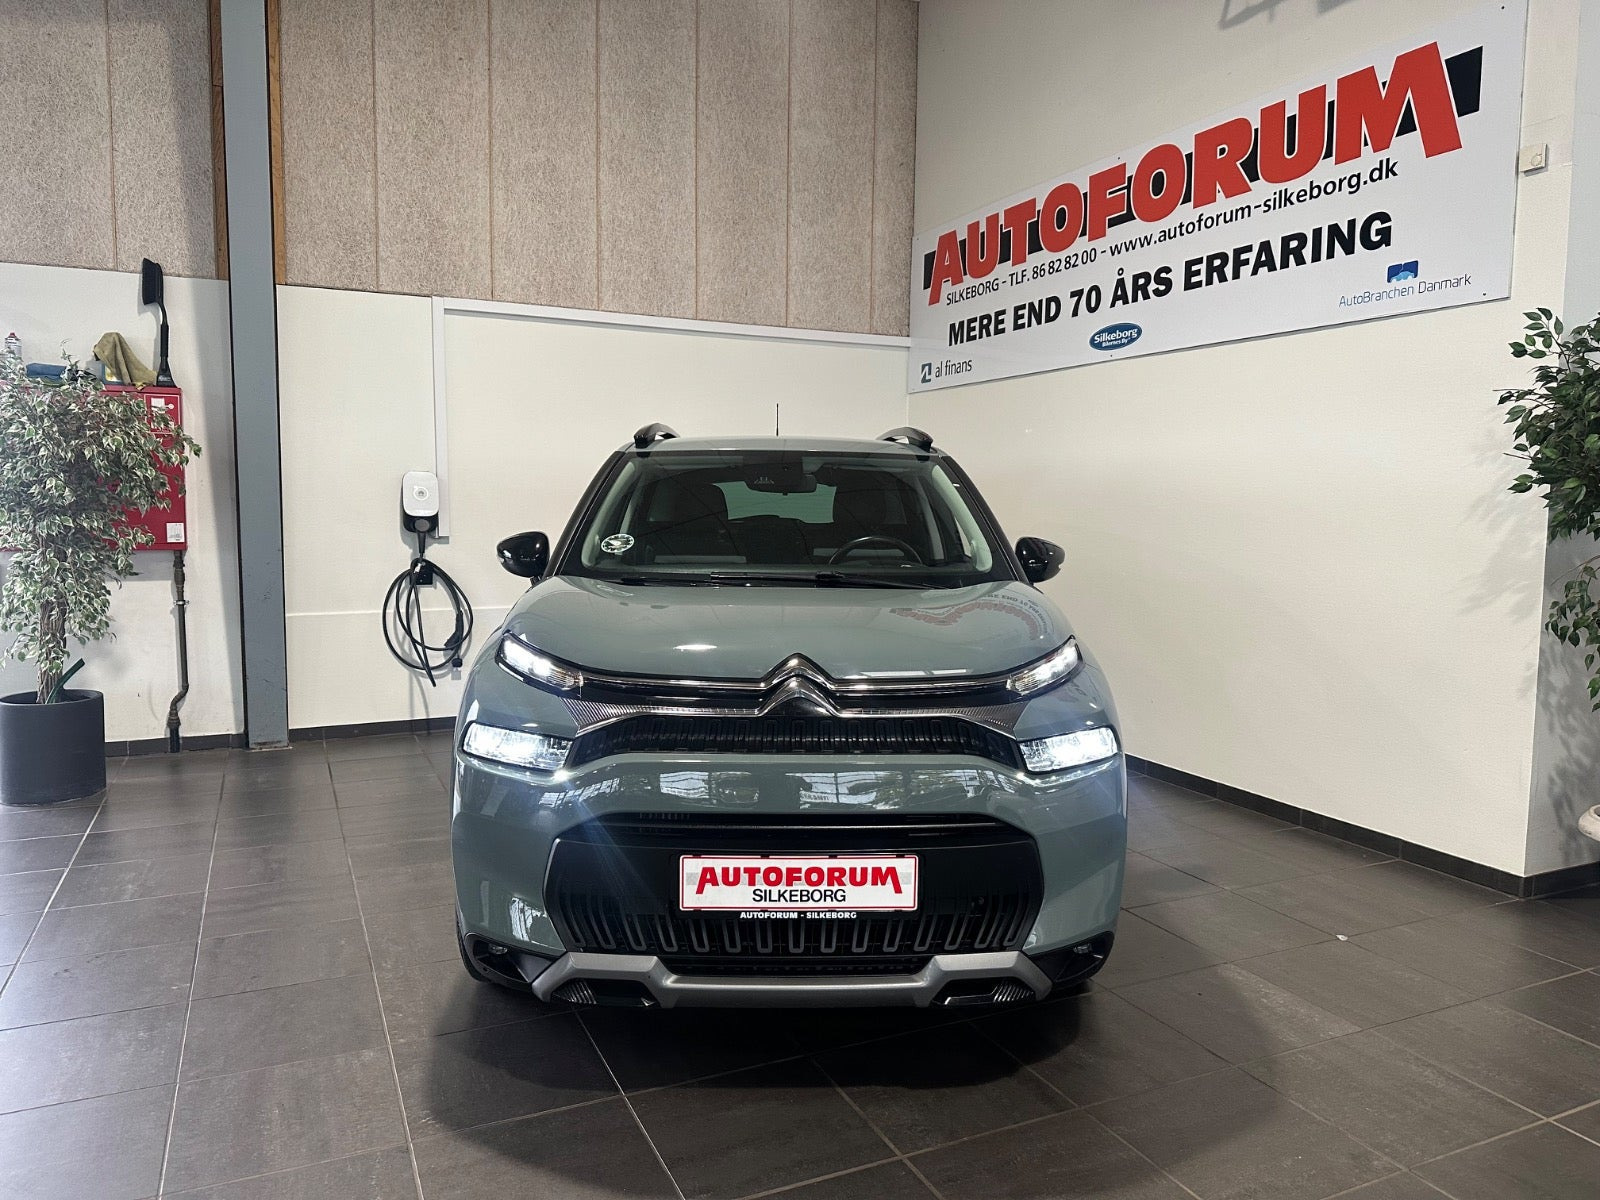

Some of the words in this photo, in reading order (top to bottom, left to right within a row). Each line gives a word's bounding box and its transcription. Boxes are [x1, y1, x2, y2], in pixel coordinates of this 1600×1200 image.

[928, 41, 1463, 306] AUTOFORUM
[946, 277, 1000, 306] SILKEBORG
[1008, 269, 1030, 287] TLF.
[1108, 158, 1399, 257] www.autoforum-silkeborg.dk
[948, 308, 1007, 347] MERE
[1012, 295, 1062, 332] END
[1069, 284, 1102, 318] 70
[1109, 267, 1173, 309] ÅRS
[1183, 211, 1393, 292] ERFARING
[1339, 285, 1414, 308] AutoBranchen
[1418, 273, 1472, 294] Danmark
[1094, 329, 1138, 344] Silkeborg
[935, 361, 943, 378] al
[944, 359, 973, 376] finans
[696, 866, 903, 894] AUTOFORUM
[752, 888, 846, 903] SILKEBORG
[740, 911, 798, 919] AUTOFORUM
[806, 911, 857, 919] SILKEBORG
